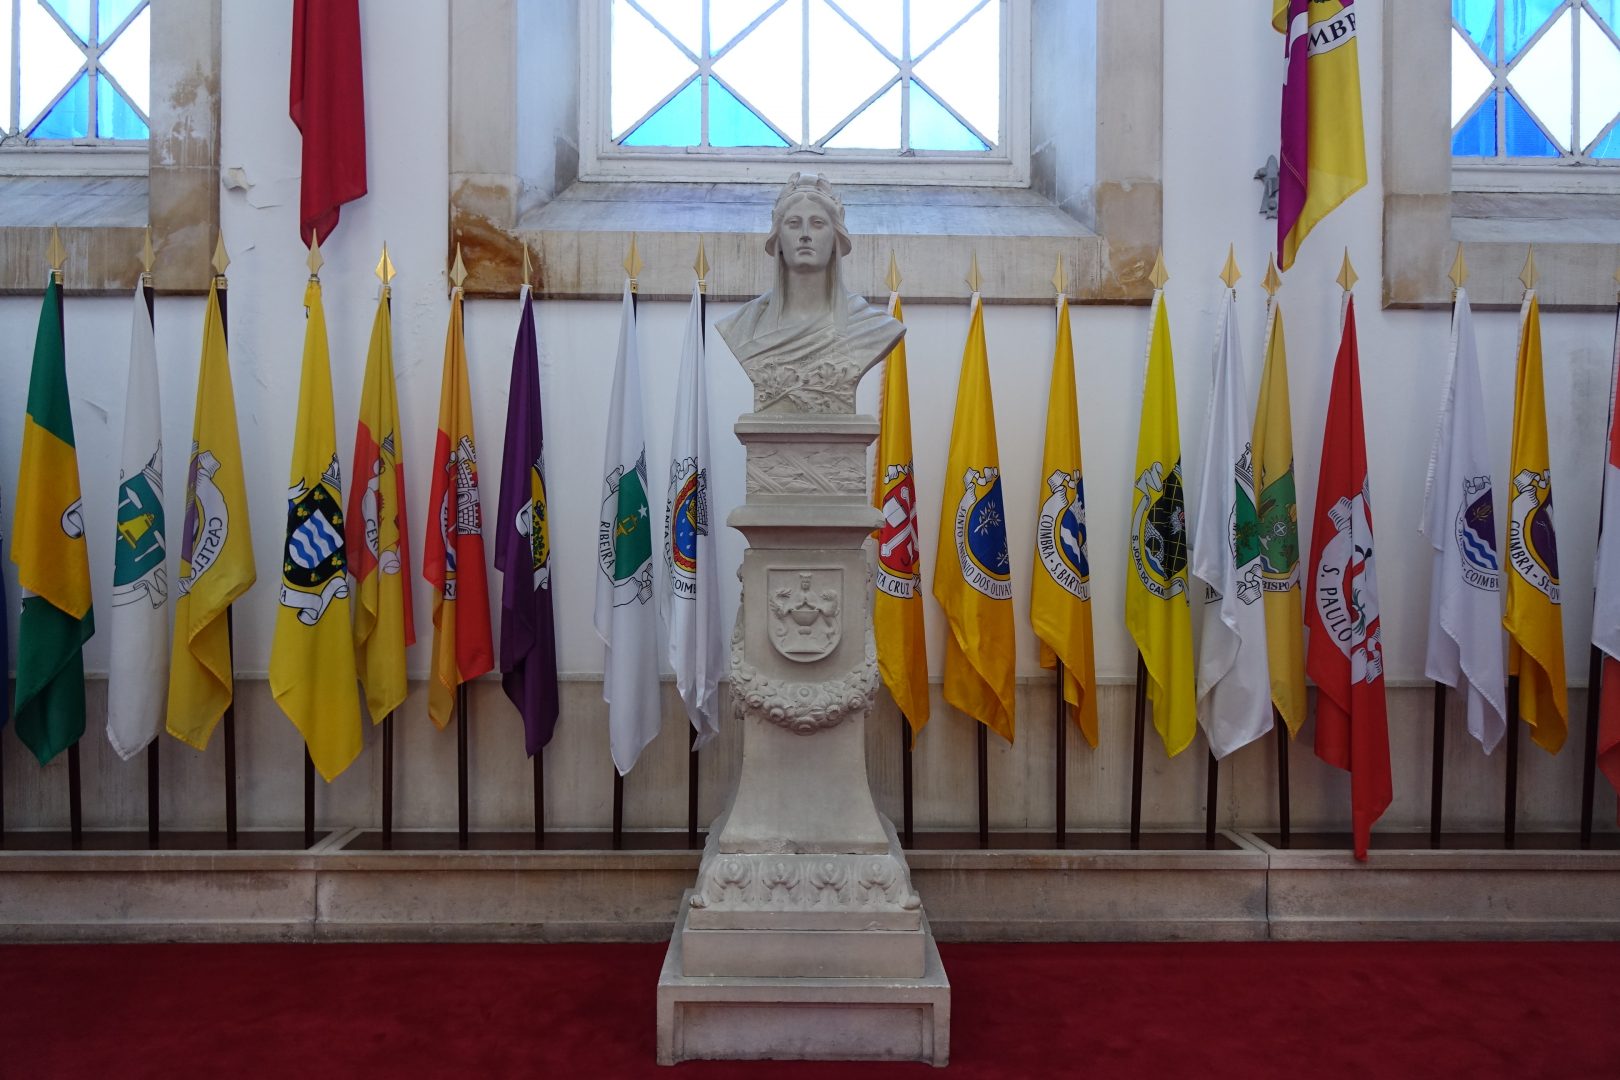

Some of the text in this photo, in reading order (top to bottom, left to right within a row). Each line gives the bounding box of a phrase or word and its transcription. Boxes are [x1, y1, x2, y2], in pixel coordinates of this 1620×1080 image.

[599, 520, 616, 570] RIBEIRA
[957, 505, 967, 538] SANTO
[972, 572, 991, 592] DOS
[1039, 514, 1055, 560] COIMBRA
[1510, 520, 1535, 575] COIMBRA
[1320, 564, 1353, 642] S. PAULO
